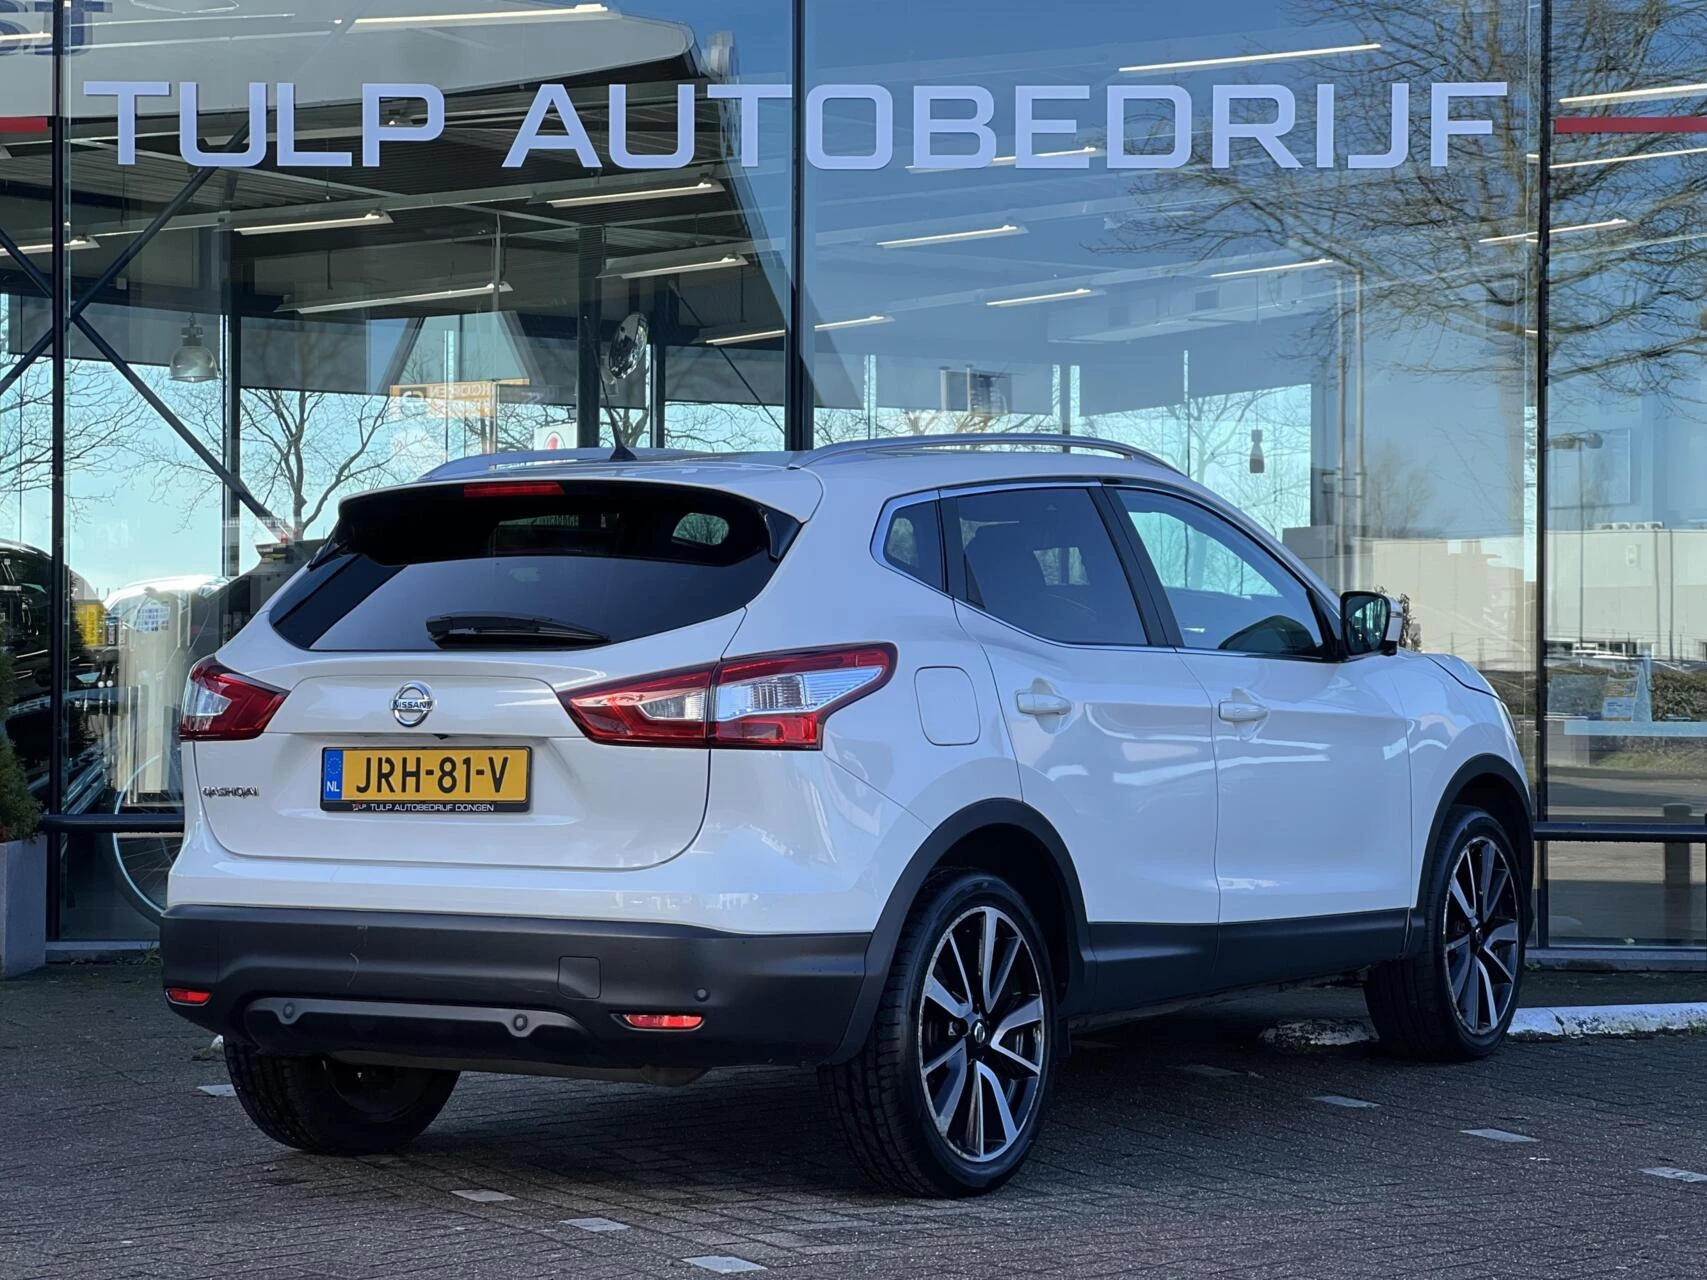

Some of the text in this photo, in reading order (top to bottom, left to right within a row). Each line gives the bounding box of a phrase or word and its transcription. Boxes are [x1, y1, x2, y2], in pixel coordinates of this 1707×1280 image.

[83, 81, 1509, 171] TULP AUTOBEDRIJF
[393, 700, 428, 709] NISSAN
[356, 756, 509, 794] JRH-81-V
[202, 786, 259, 799] QASHQAI
[326, 780, 341, 793] NL
[370, 803, 495, 812] TULP AUTOBEDRIJF DONGEN
